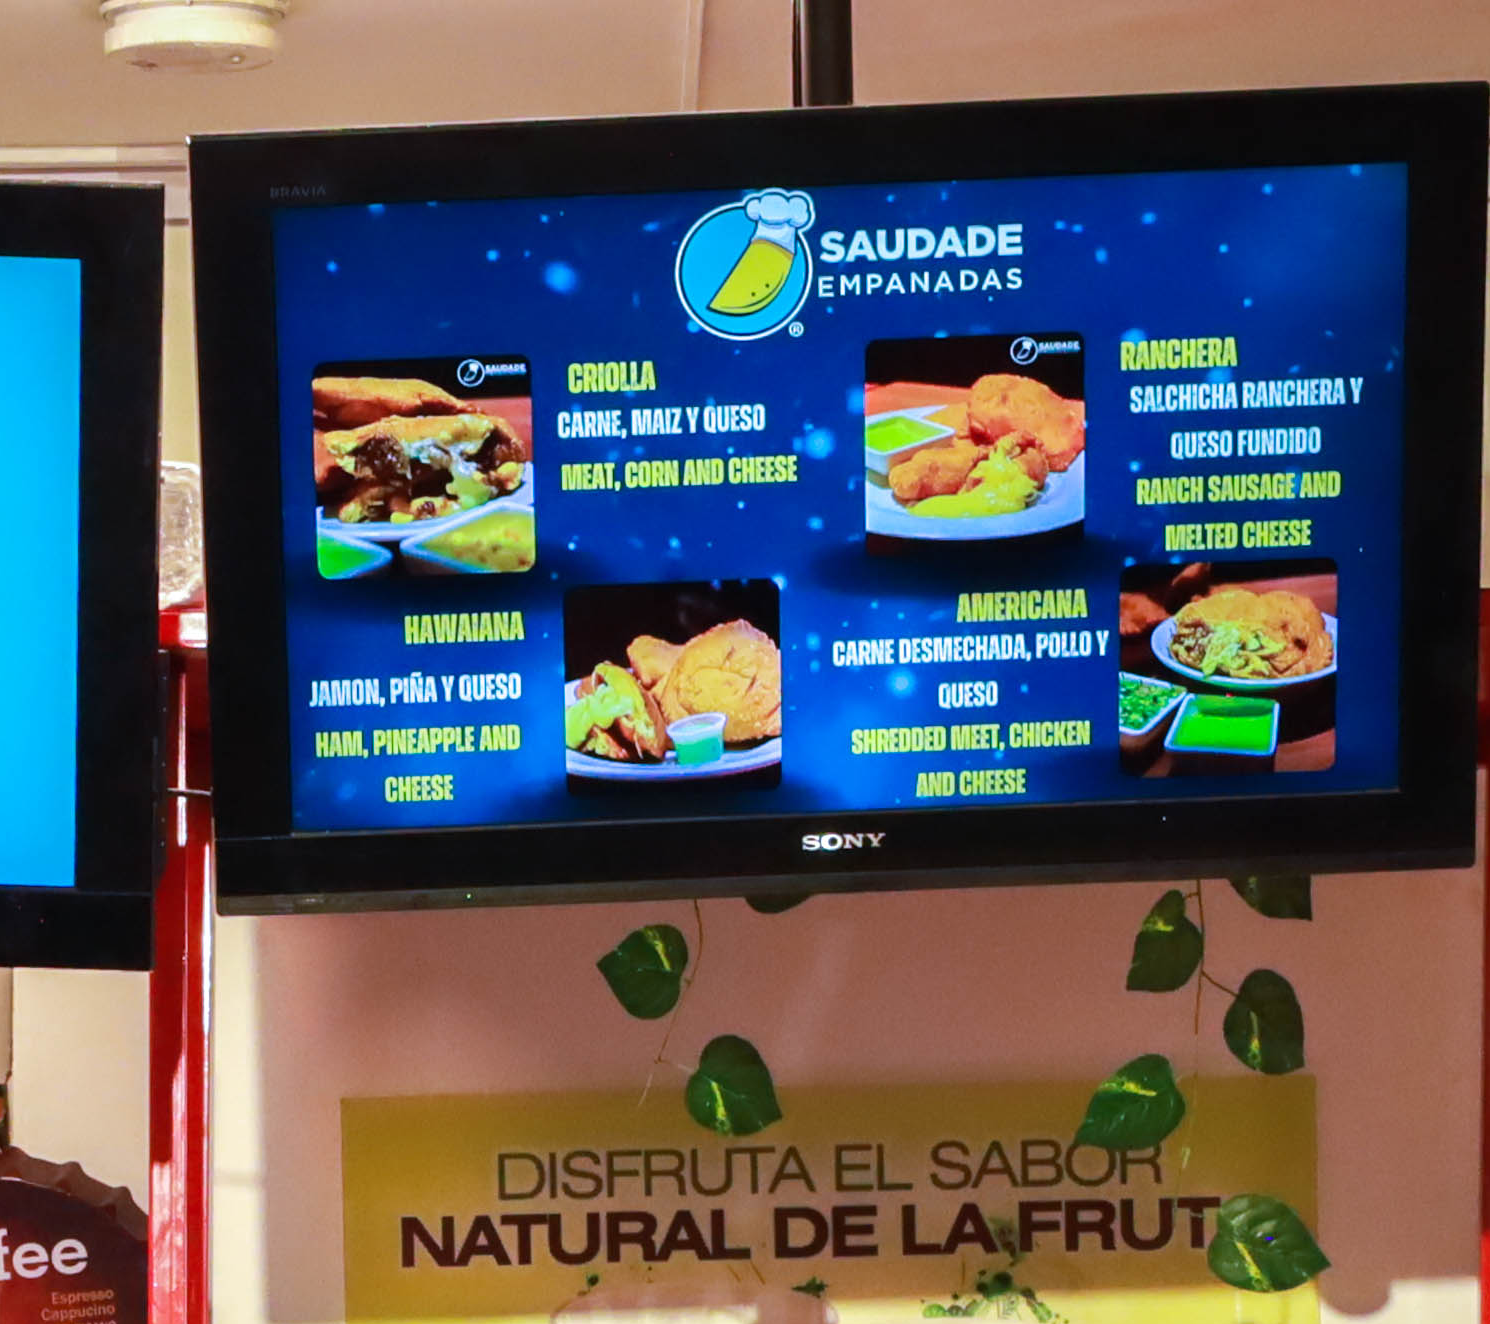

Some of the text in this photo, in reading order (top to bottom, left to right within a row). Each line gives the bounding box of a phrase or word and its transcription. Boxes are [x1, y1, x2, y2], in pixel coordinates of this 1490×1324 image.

[820, 224, 1023, 263] SAUDADE
[818, 268, 1023, 298] EMPANADAS
[1120, 337, 1237, 371] RANCHERA
[568, 361, 655, 394] CRIOLLA
[1129, 377, 1363, 414] SALCHICHA RANCHERA Y
[557, 404, 765, 439] CARNE, MAIZ Y QUESO
[1171, 427, 1322, 460] QUESO FUNDIDO
[561, 455, 798, 491] MEAT, CORN AND CHEESE
[1136, 471, 1342, 506] RANCH SAUSAGE AND
[1165, 519, 1312, 552] MELTED CHEESE
[956, 589, 1088, 622] AMERICANA
[404, 611, 525, 646] HAWAIANA
[832, 630, 1110, 667] CARNE DESMECHADA, POLLO Y
[309, 672, 522, 709] JAMON, PIÑA Y QUESO
[938, 681, 999, 710] QUESO
[315, 724, 521, 759] HAM, PINEAPPLE AND
[851, 720, 1091, 755] SHREDDED MEET, CHICKEN
[384, 775, 454, 803] CHEESE
[916, 769, 1027, 798] AND CHEESE
[801, 832, 886, 852] SONY
[496, 1138, 1163, 1201] DISFRUTA EL SABOR
[400, 1197, 1221, 1268] NATURAL DE LA FRUT
[40, 1304, 117, 1323] Cappucino
[51, 1289, 115, 1305] Espresso
